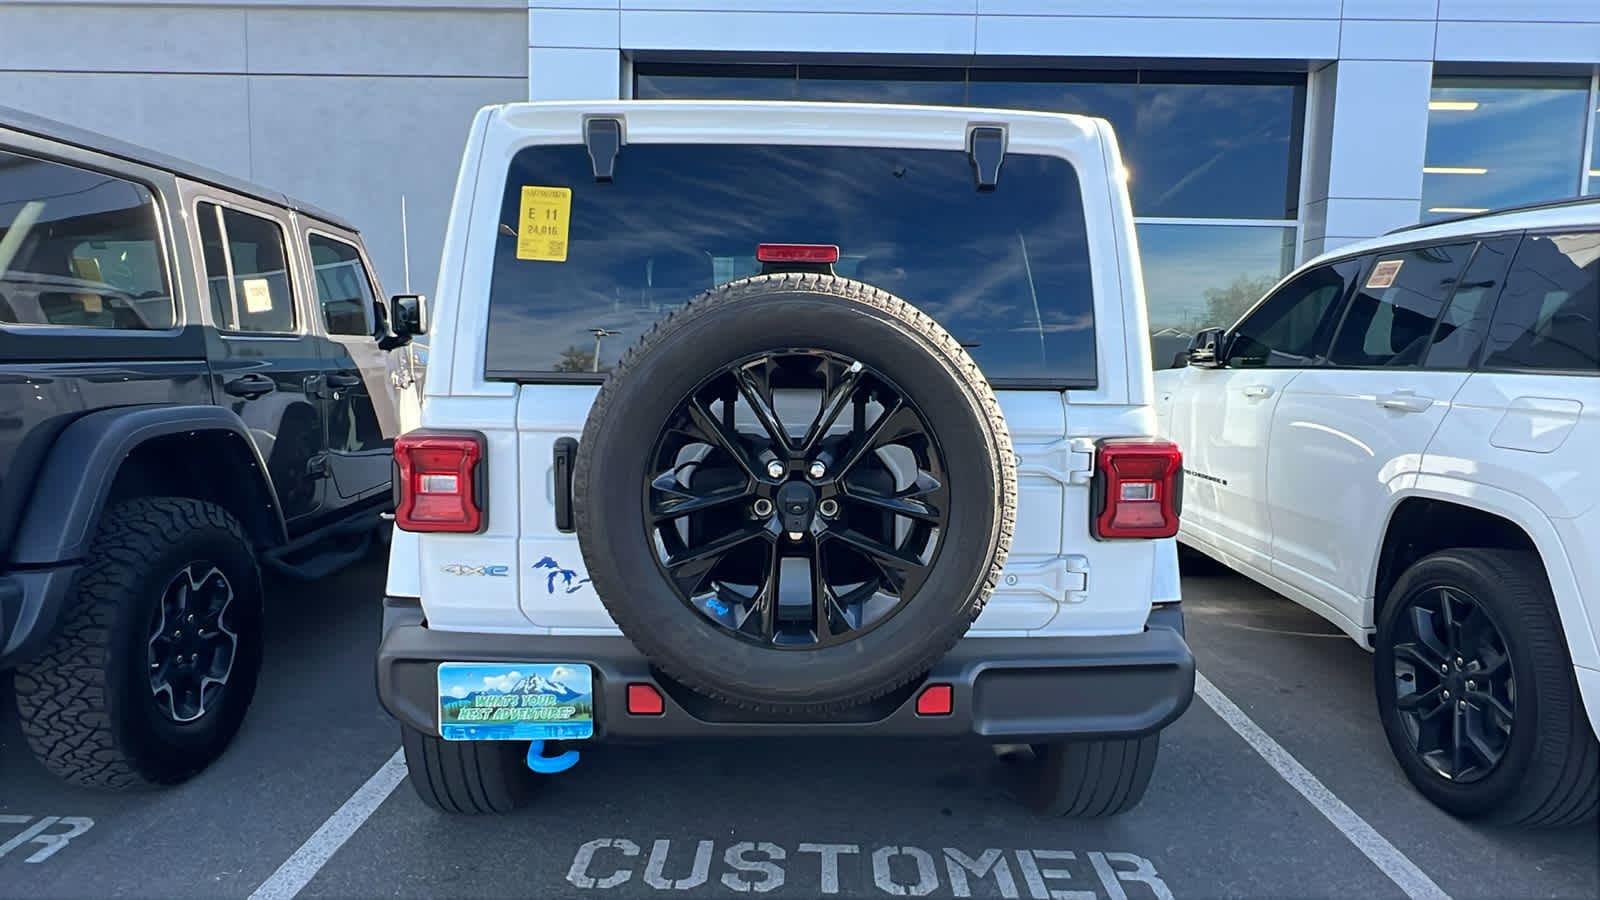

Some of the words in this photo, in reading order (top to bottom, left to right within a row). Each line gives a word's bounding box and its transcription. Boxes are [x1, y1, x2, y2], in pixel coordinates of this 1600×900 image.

[528, 207, 536, 220] E
[545, 208, 558, 221] 11
[521, 694, 557, 708] YOUR
[457, 706, 493, 721] NEXT
[491, 706, 576, 721] ADVENTURE?
[565, 838, 1176, 900] CUSTOMER
